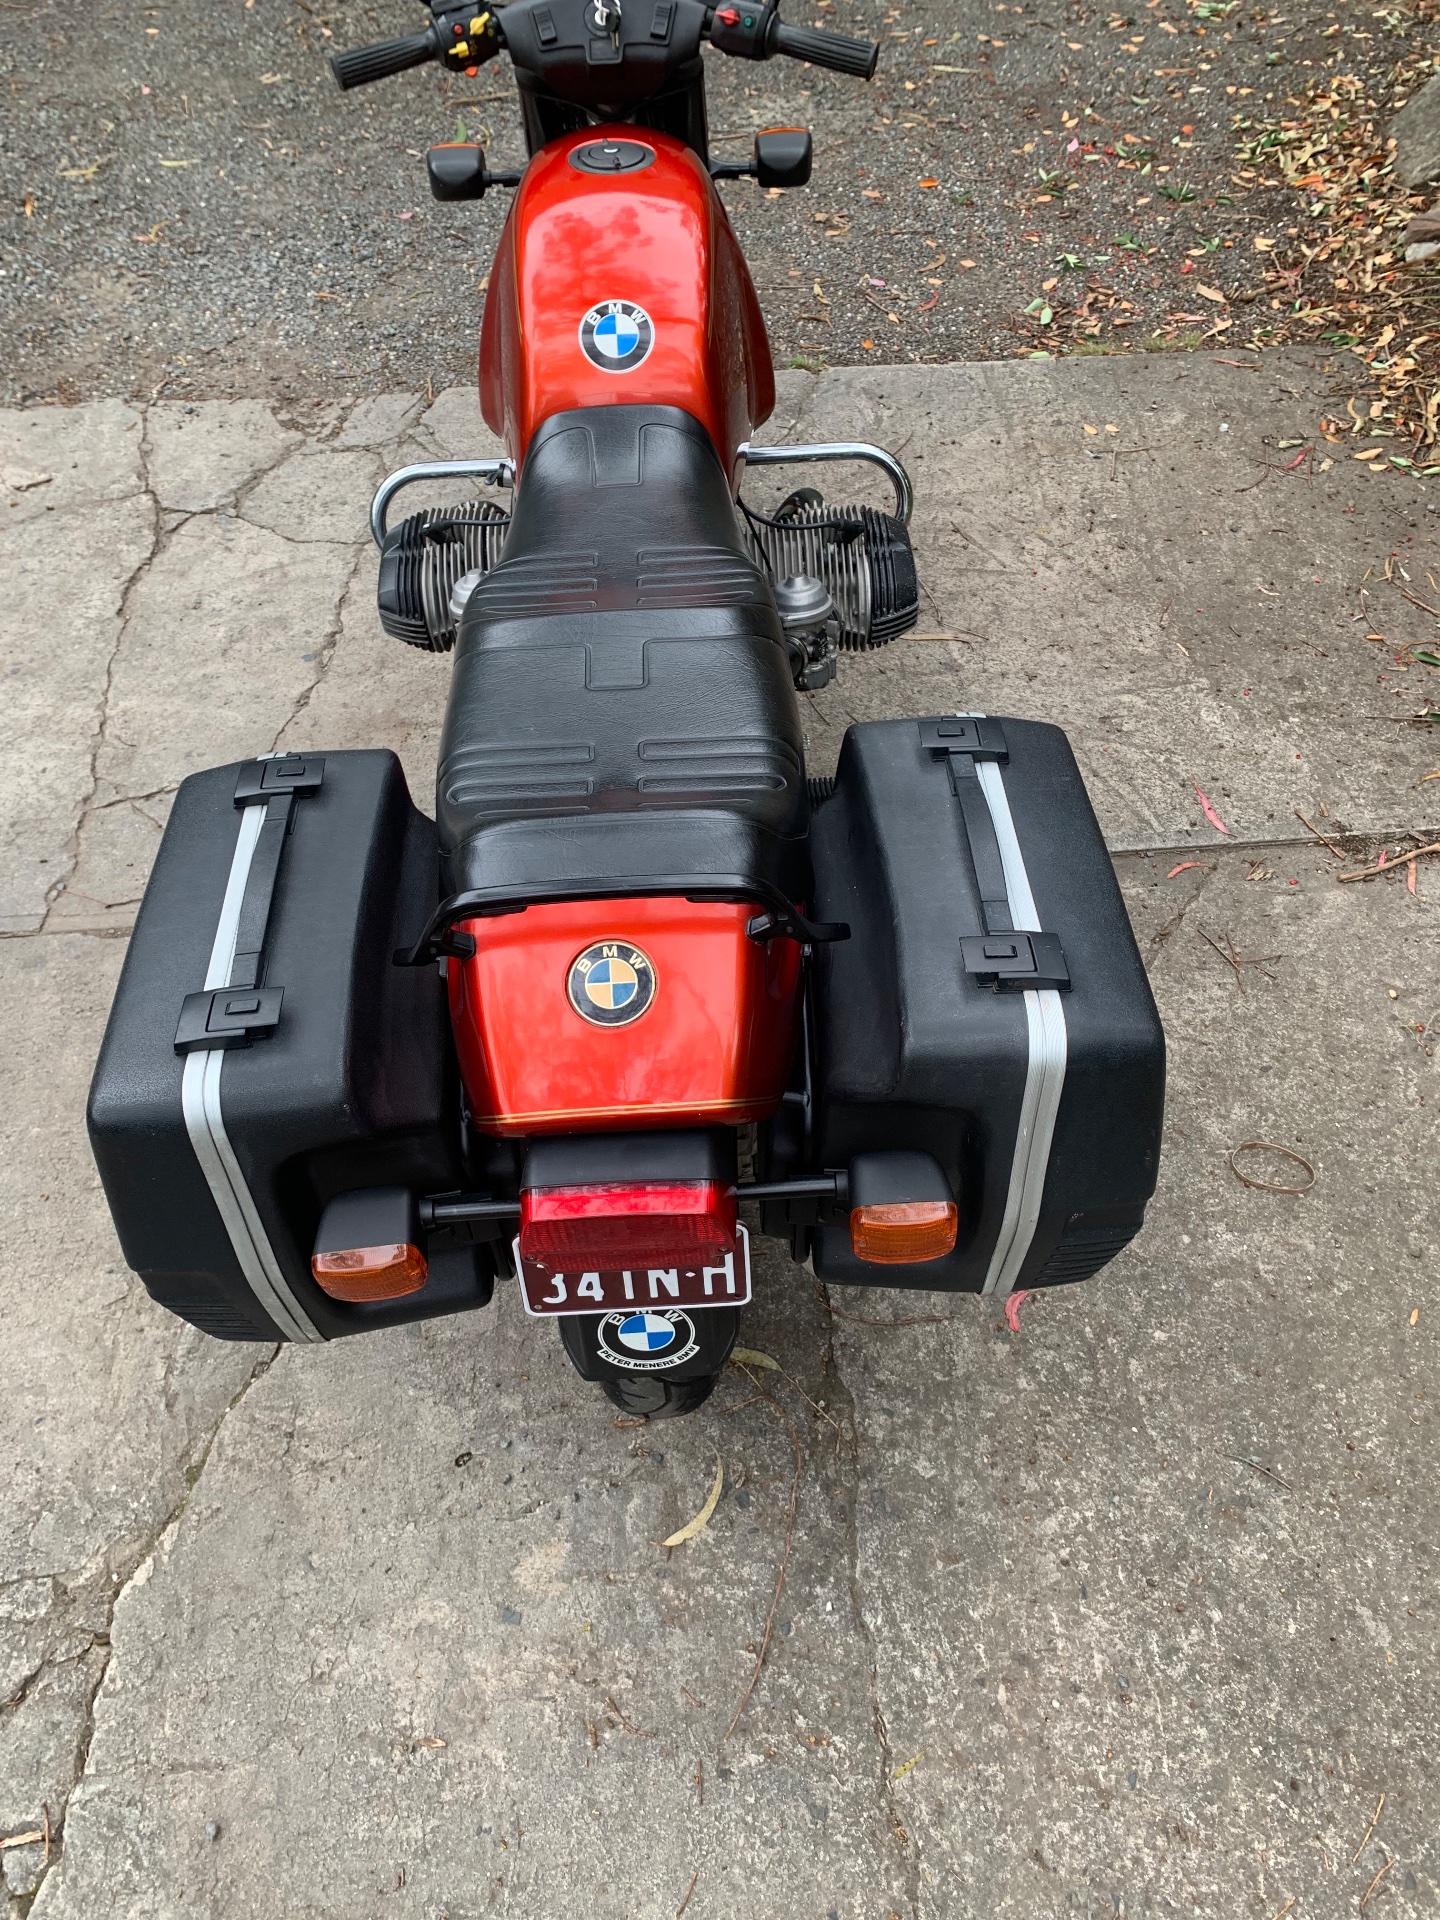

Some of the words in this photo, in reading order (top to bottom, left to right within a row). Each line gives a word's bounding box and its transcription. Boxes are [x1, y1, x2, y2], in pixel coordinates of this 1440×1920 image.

[586, 303, 647, 326] BMW
[576, 945, 646, 974] BMW
[600, 1349, 632, 1367] PETER
[632, 1359, 677, 1369] MENERE
[676, 1345, 696, 1361] BMW
